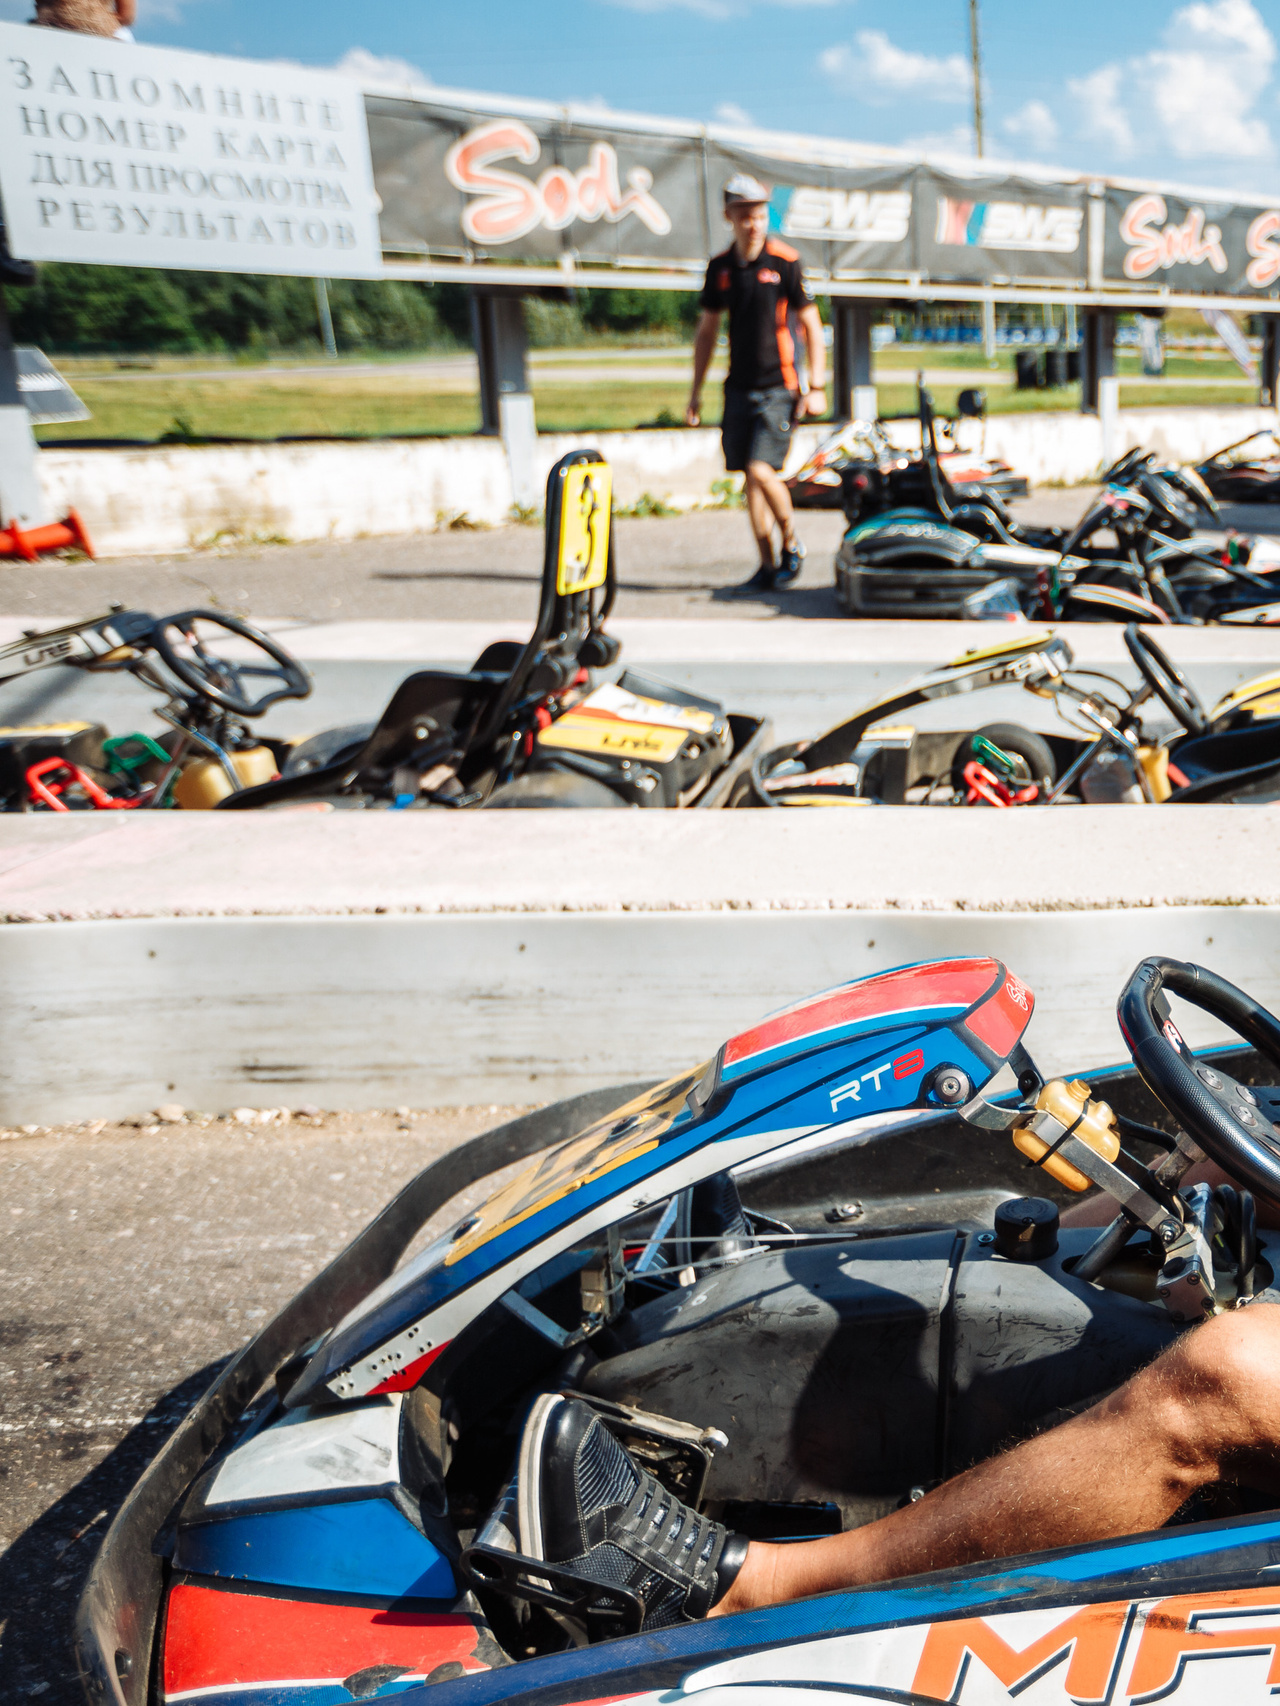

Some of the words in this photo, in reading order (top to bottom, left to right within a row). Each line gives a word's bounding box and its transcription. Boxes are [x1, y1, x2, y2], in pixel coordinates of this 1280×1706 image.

[8, 56, 343, 132] ЗАПОМНИТЕ
[19, 105, 186, 154] НОМЕР
[214, 127, 347, 172] КАРТА
[31, 152, 117, 190] ДЛЯ
[127, 161, 352, 213] ПРОСМОТРА
[444, 118, 672, 245] Sodi
[36, 197, 357, 250] РЕЗУЛЬТАТОВ
[828, 1048, 925, 1113] RT8
